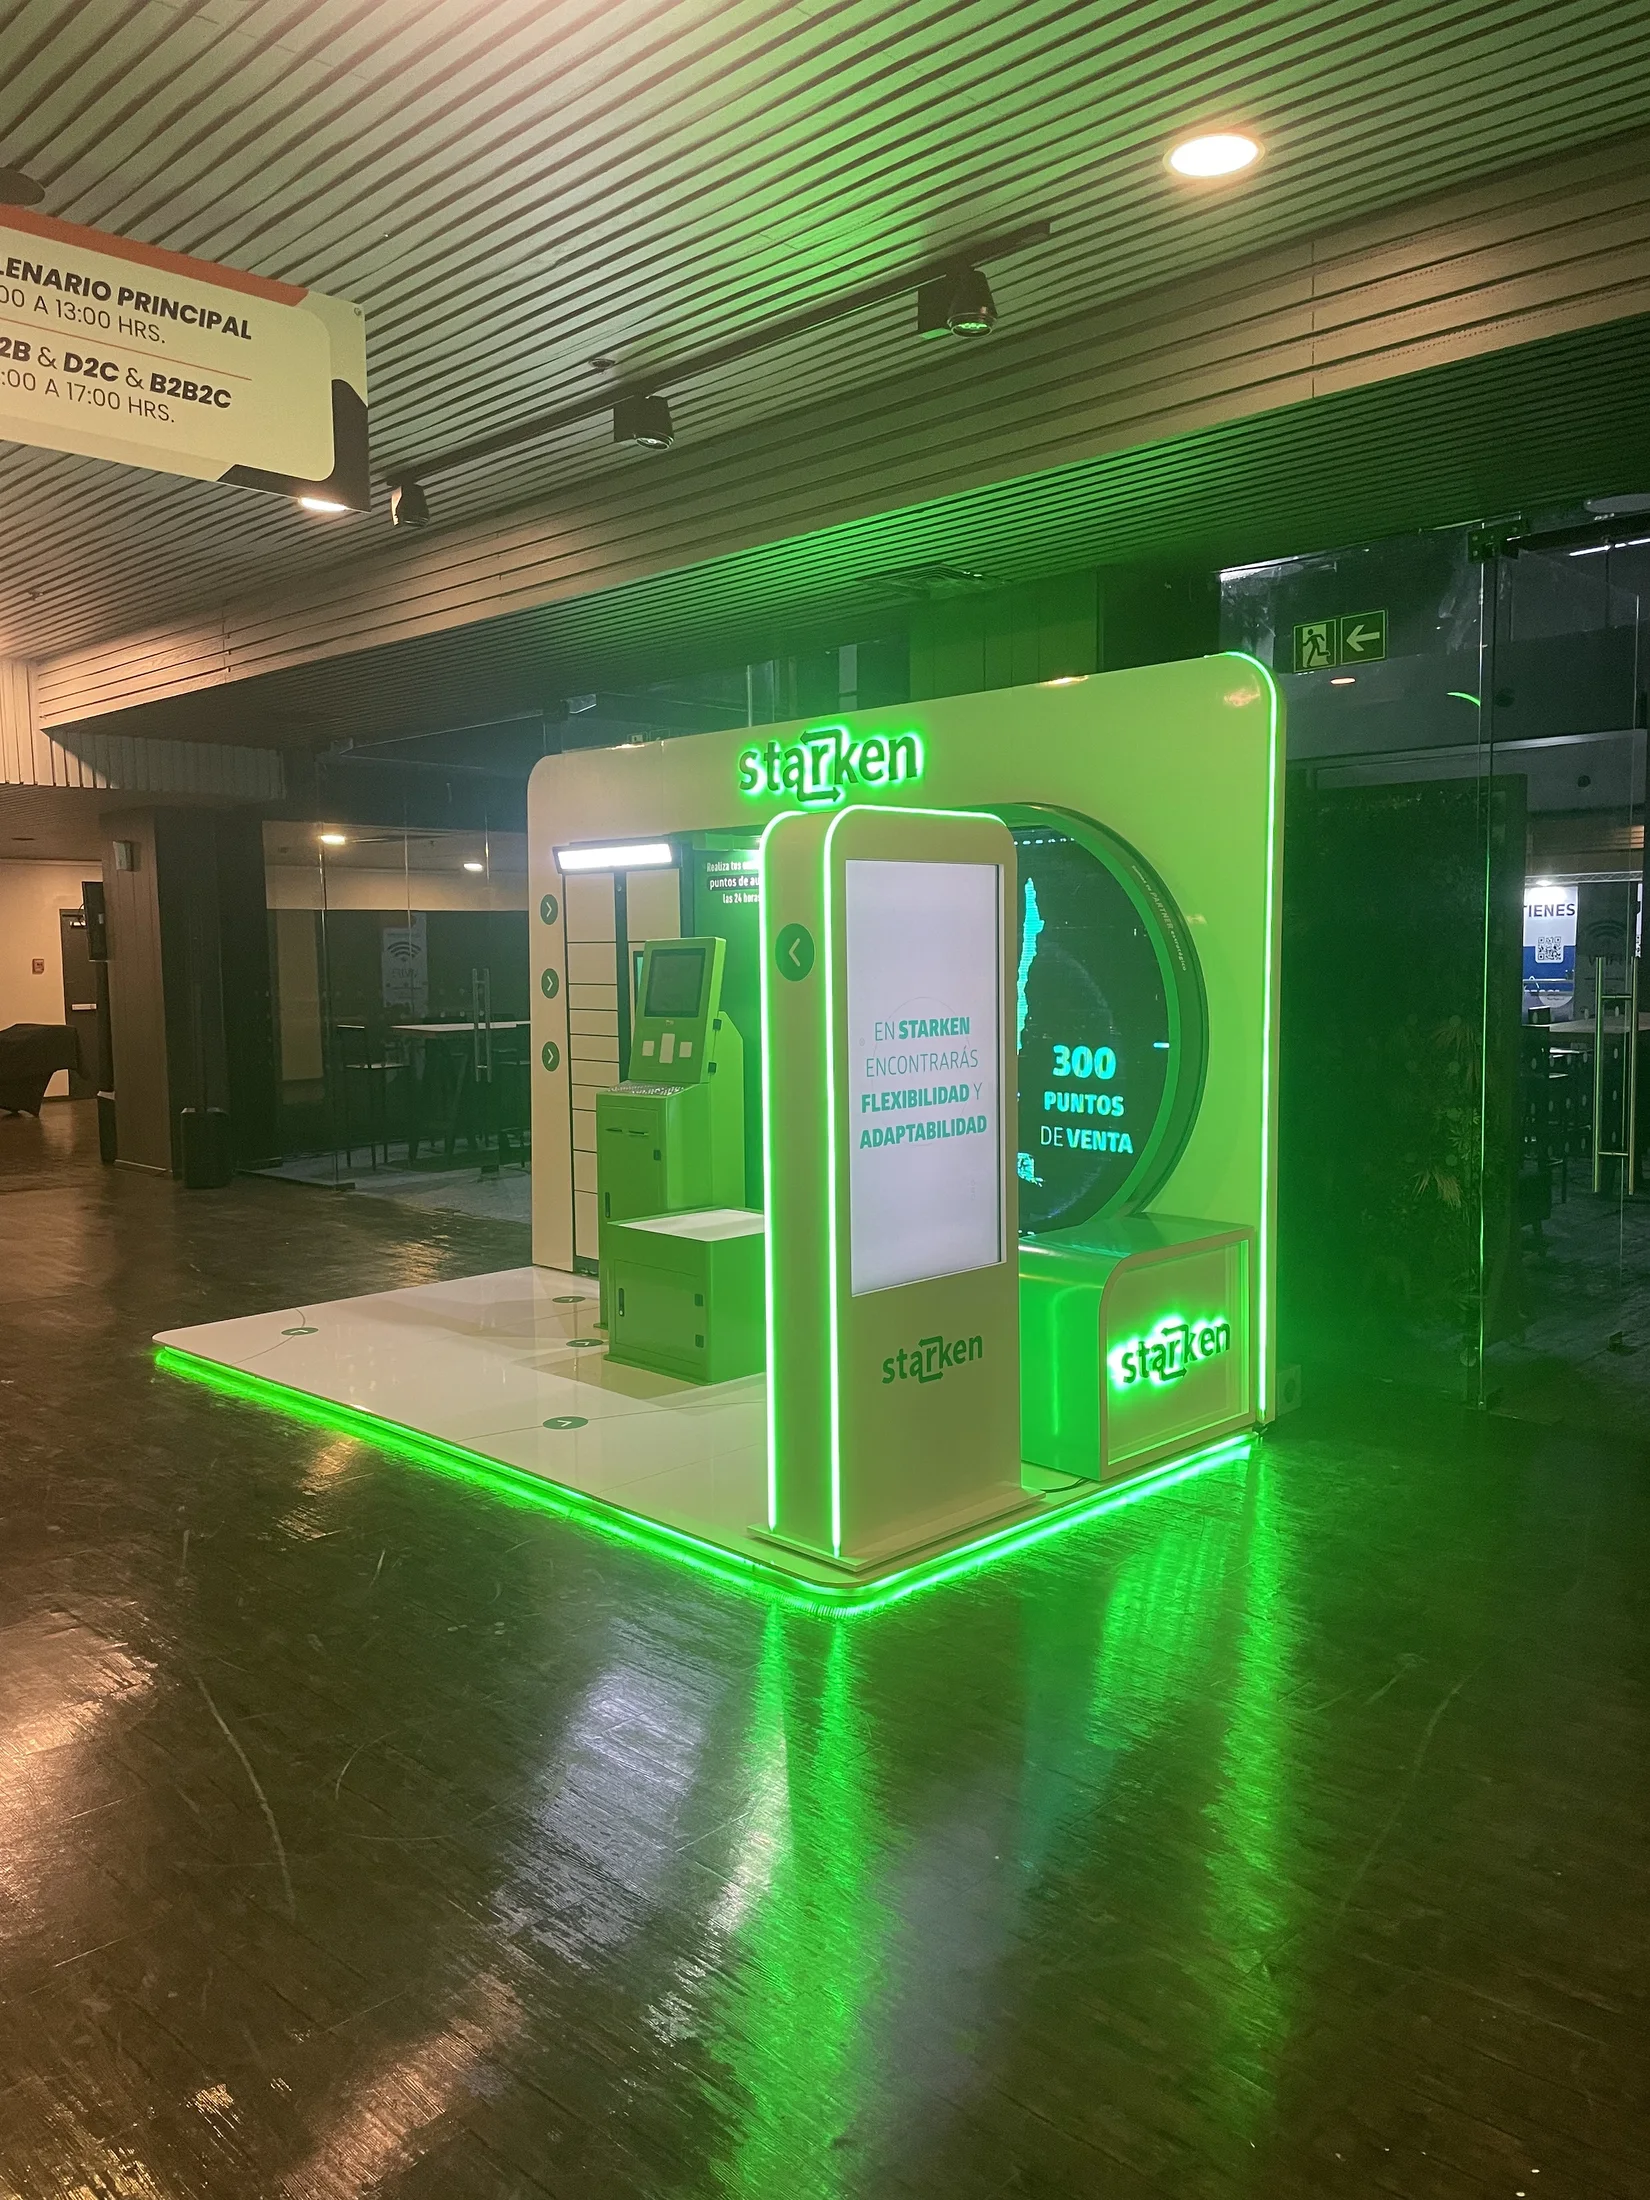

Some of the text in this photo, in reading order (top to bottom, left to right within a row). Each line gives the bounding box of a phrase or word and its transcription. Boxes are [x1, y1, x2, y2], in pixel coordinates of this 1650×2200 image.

[33, 295, 49, 315] A
[56, 299, 111, 329] 13:00
[118, 315, 166, 344] HRS.
[116, 286, 253, 340] PRINCIPAL
[37, 346, 58, 370] &
[63, 352, 120, 383] D2C
[125, 367, 145, 391] &
[149, 372, 232, 409] B2B2C
[44, 378, 60, 398] A
[66, 381, 121, 410] 17:00
[128, 396, 175, 424] HRS.
[739, 728, 919, 802] starken
[706, 861, 730, 873] Realiza
[730, 861, 742, 871] tus
[709, 877, 737, 891] puntos
[738, 875, 749, 886] de
[722, 893, 733, 904] las
[734, 892, 743, 904] 24
[1149, 891, 1174, 930] PARTNER
[1523, 903, 1576, 918] IENES
[874, 1016, 970, 1041] EN STARKEN
[865, 1045, 979, 1078] ENCONTRARÁS
[1052, 1044, 1117, 1080] 300
[861, 1082, 984, 1113] FLEXIBILIDAD Y
[1044, 1090, 1125, 1117] PUNTOS
[859, 1115, 988, 1149] ADAPTABILIDAD
[1040, 1125, 1134, 1154] DE VENTA
[881, 1334, 984, 1384] starken
[1121, 1321, 1232, 1384] starken
